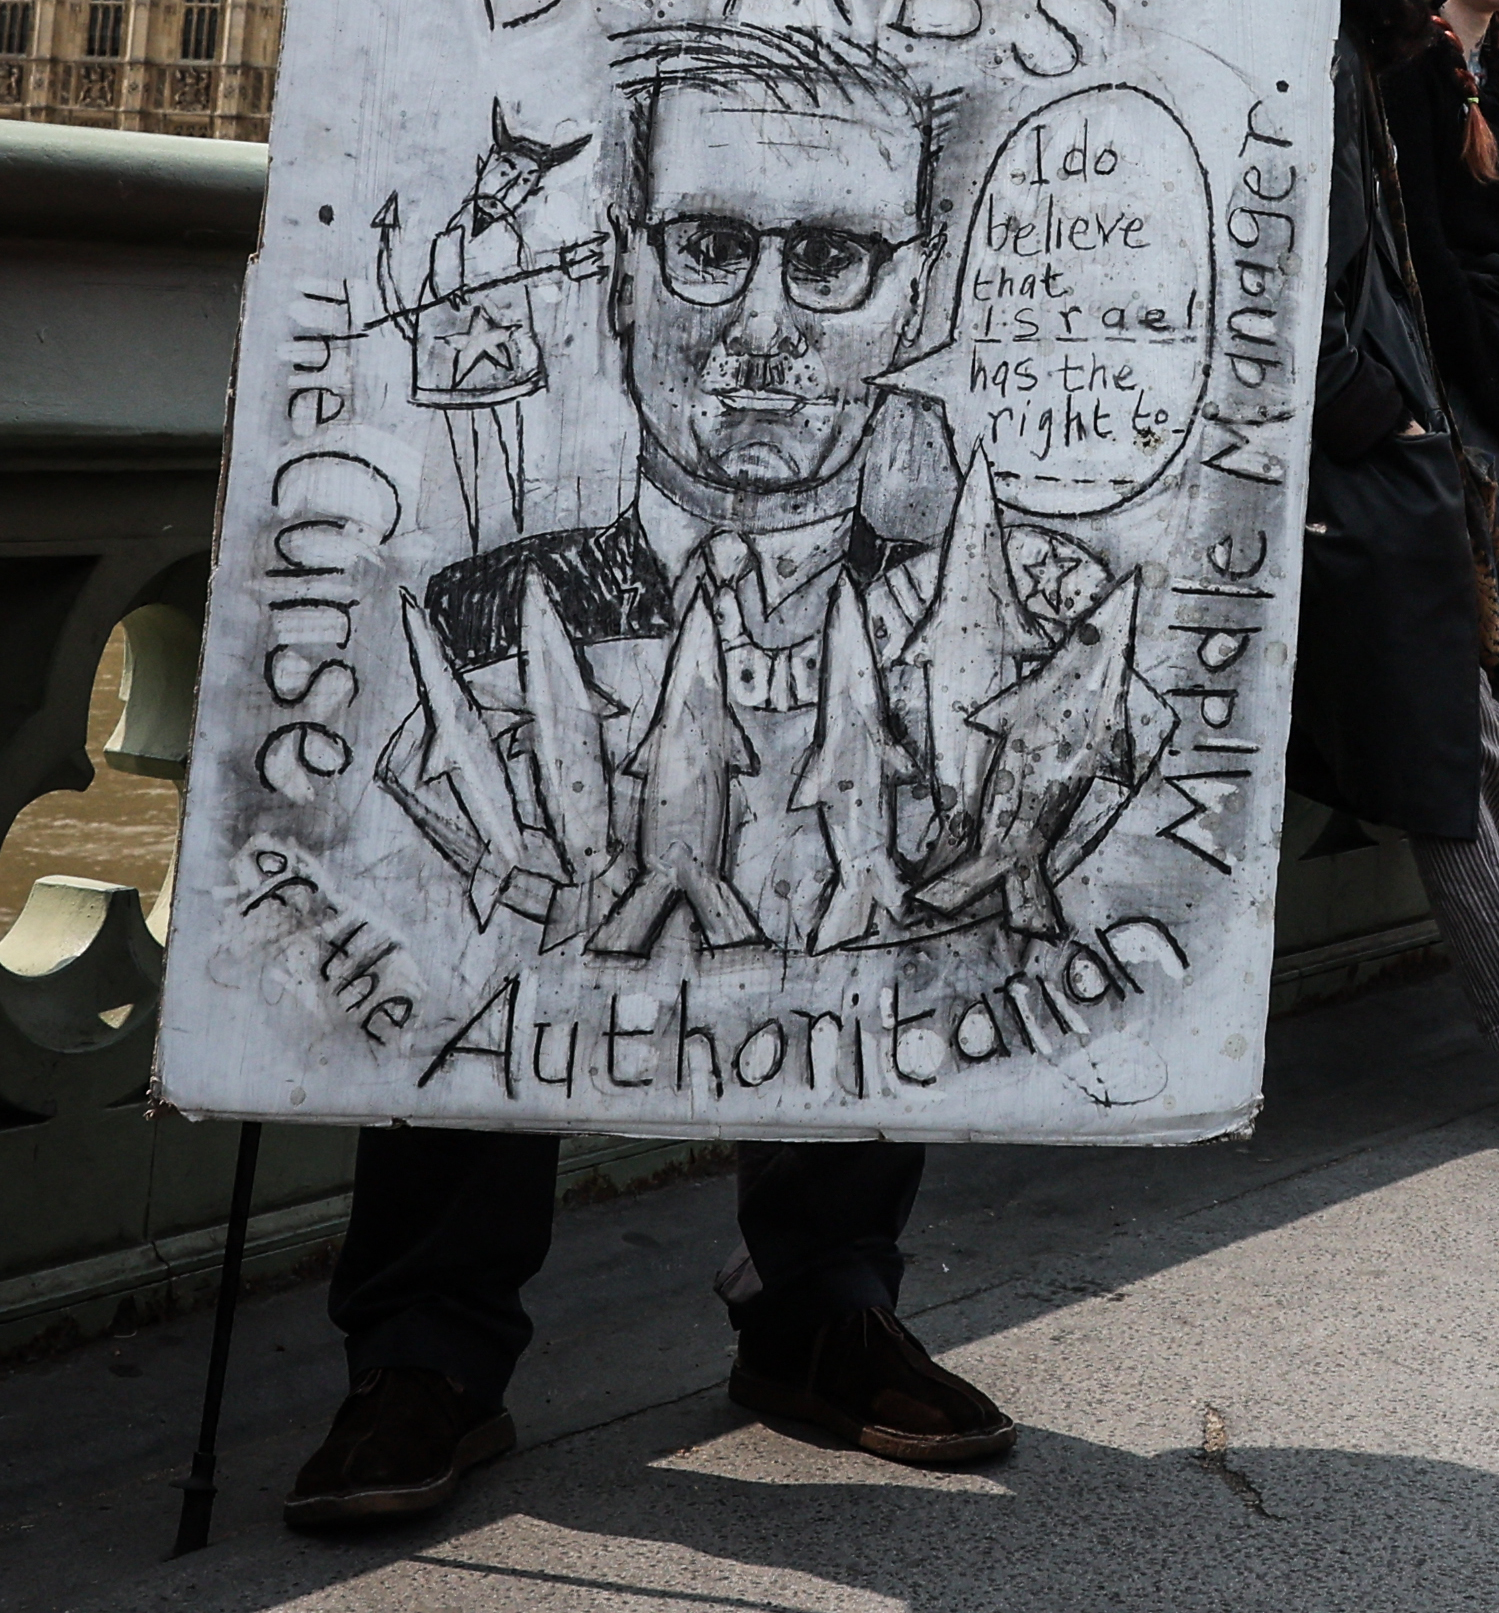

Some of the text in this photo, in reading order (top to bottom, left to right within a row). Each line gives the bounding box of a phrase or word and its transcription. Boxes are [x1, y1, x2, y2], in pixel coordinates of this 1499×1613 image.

[1029, 118, 1119, 186] I do
[986, 192, 1150, 257] believe
[972, 262, 1067, 301] that
[970, 344, 1139, 398] has the
[987, 392, 1113, 461] right
[254, 279, 402, 793] The Curse
[1155, 530, 1276, 875] Middle
[240, 849, 414, 1047] of the
[416, 915, 1189, 1100] Authoritarian
